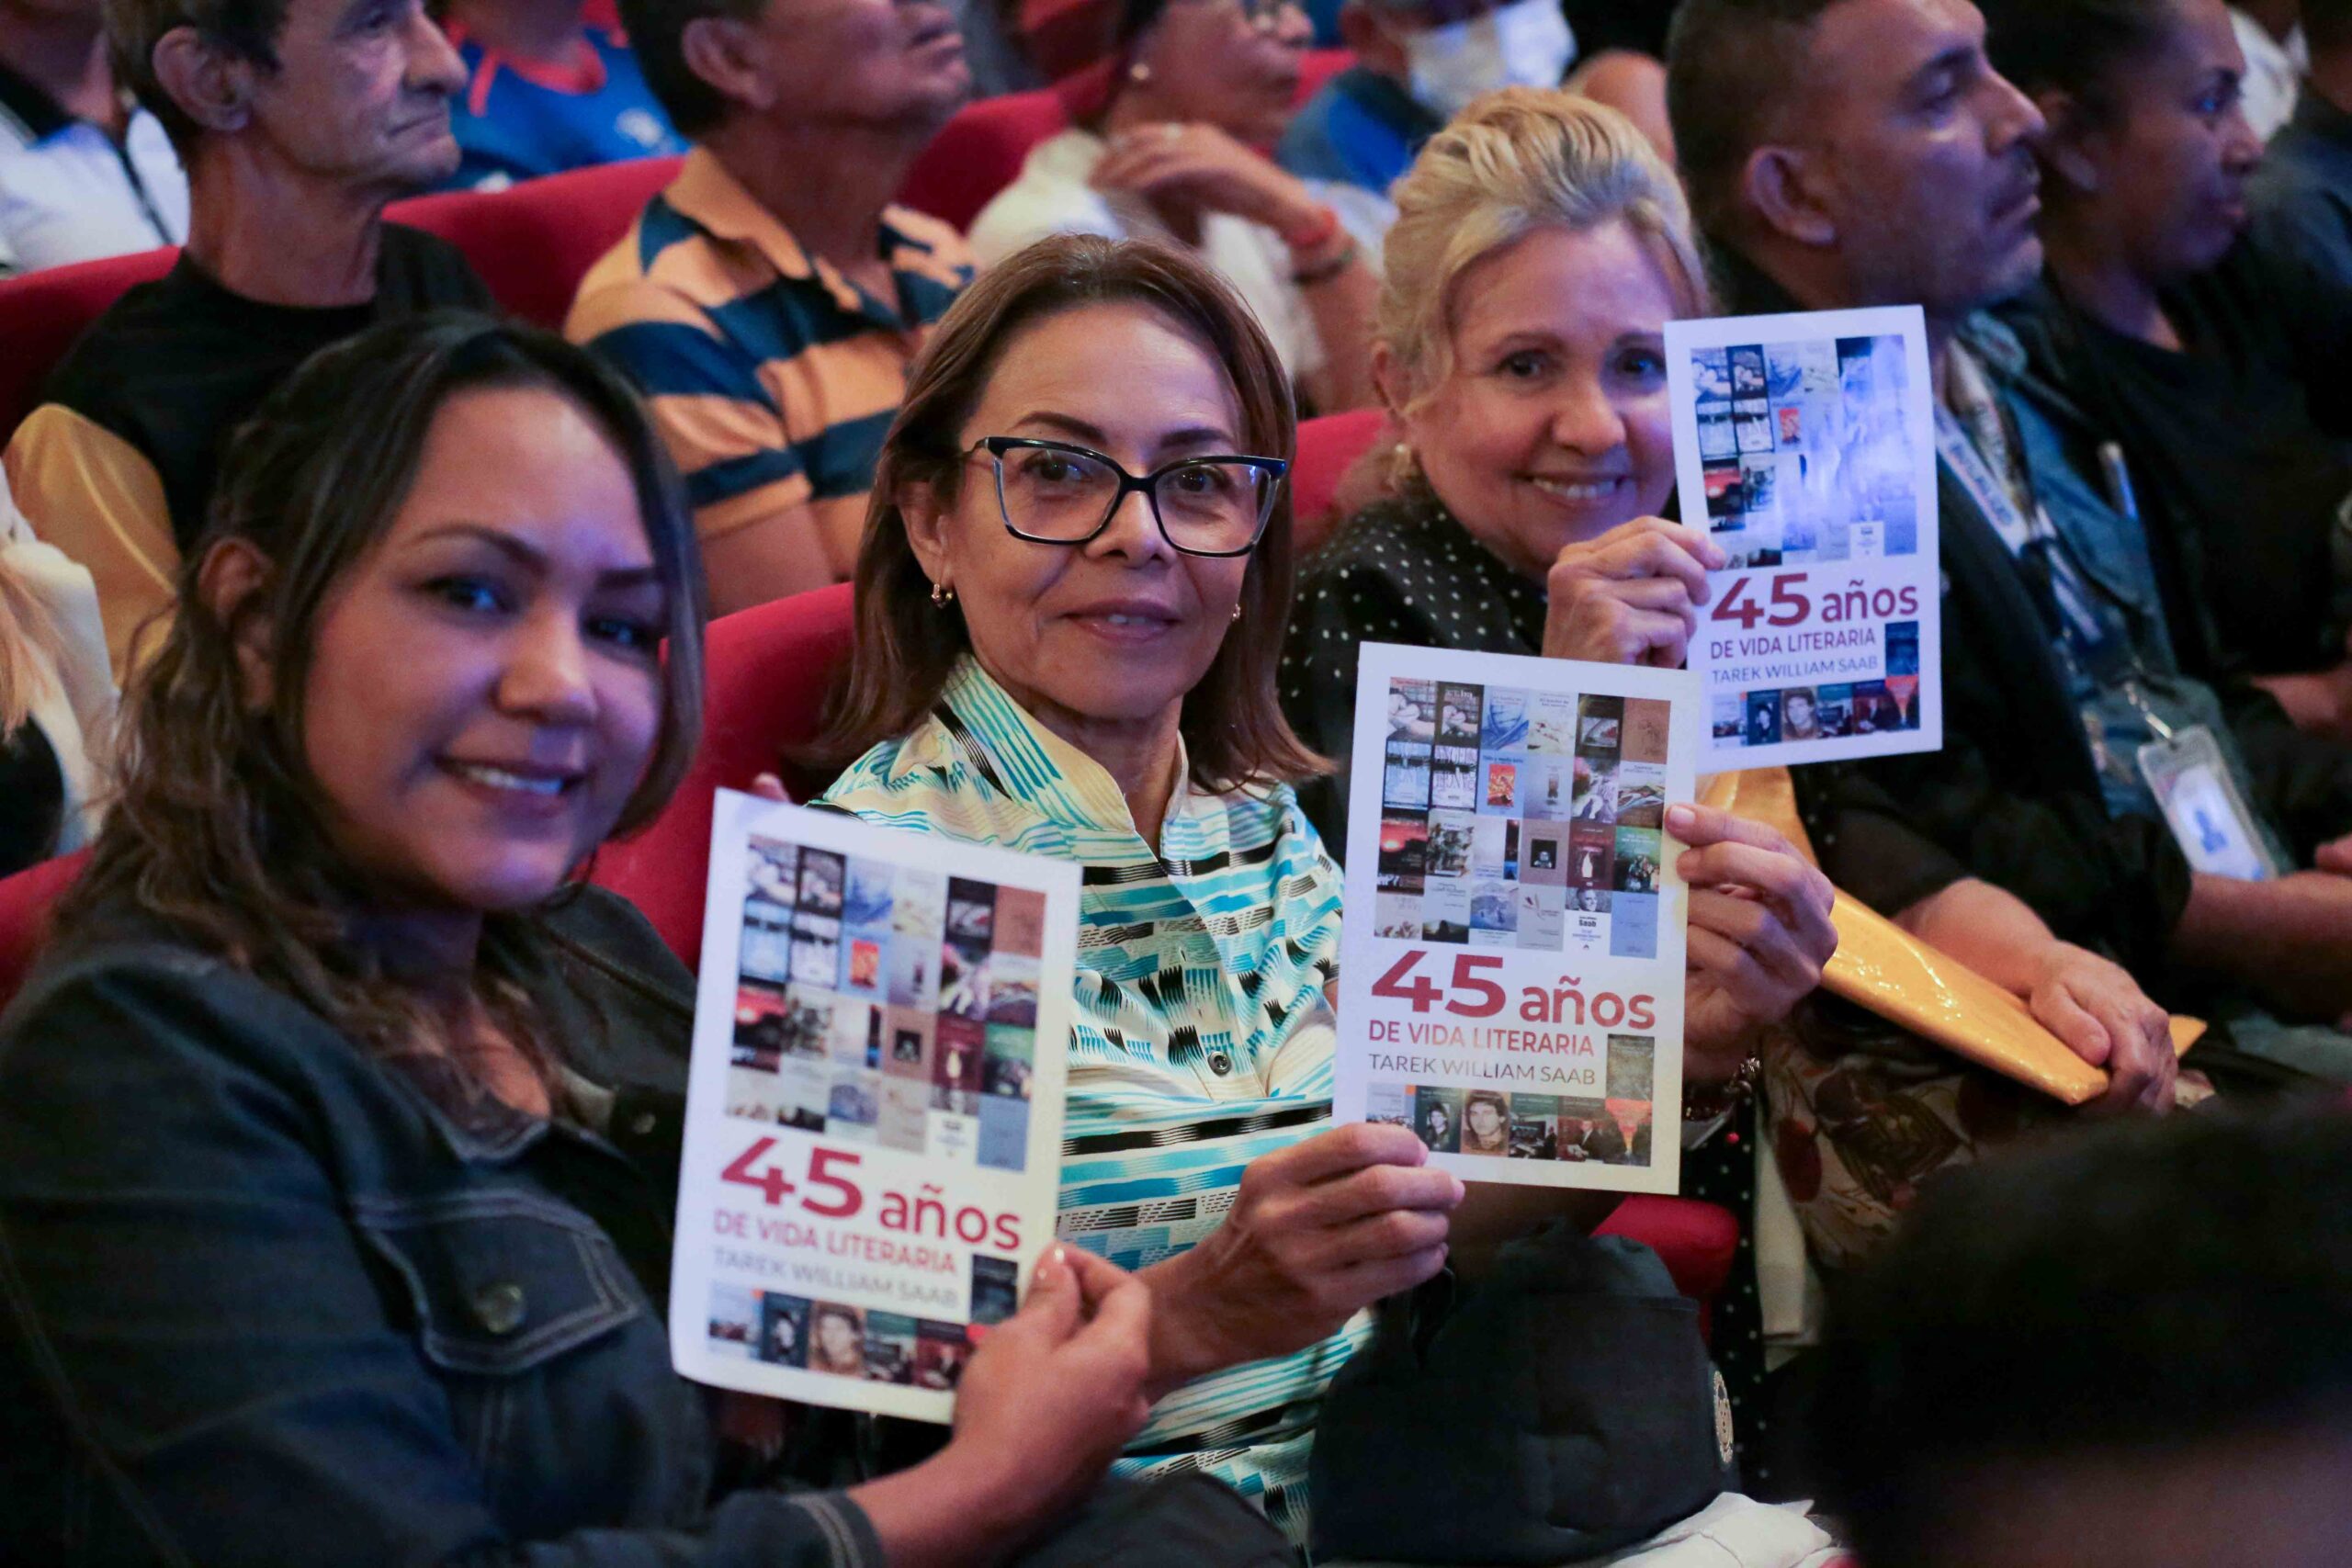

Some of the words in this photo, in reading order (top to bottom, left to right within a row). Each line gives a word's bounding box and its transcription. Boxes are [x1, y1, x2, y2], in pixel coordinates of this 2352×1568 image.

[1711, 572, 1810, 629] 45
[1822, 580, 1918, 624] años
[1711, 641, 1733, 659] DE
[1740, 636, 1782, 656] VIDA
[1788, 629, 1875, 652] LITERARIA
[1713, 667, 1761, 682] TAREK
[1766, 660, 1835, 679] WILLIAM
[1838, 657, 1878, 673] SAAB
[1371, 950, 1506, 1018] 45
[1520, 976, 1656, 1030] años
[1369, 1020, 1400, 1043] DE
[1408, 1023, 1464, 1046] VIDA
[1474, 1028, 1594, 1055] LITERARIA
[1369, 1054, 1437, 1075] TAREK
[1442, 1059, 1534, 1081] WILLIAM
[1540, 1066, 1595, 1085] SAAB
[721, 1136, 863, 1218] 45
[879, 1184, 1021, 1250] años
[714, 1209, 750, 1237] DE
[759, 1217, 818, 1247] VIDA
[827, 1229, 956, 1273] LITERARIA
